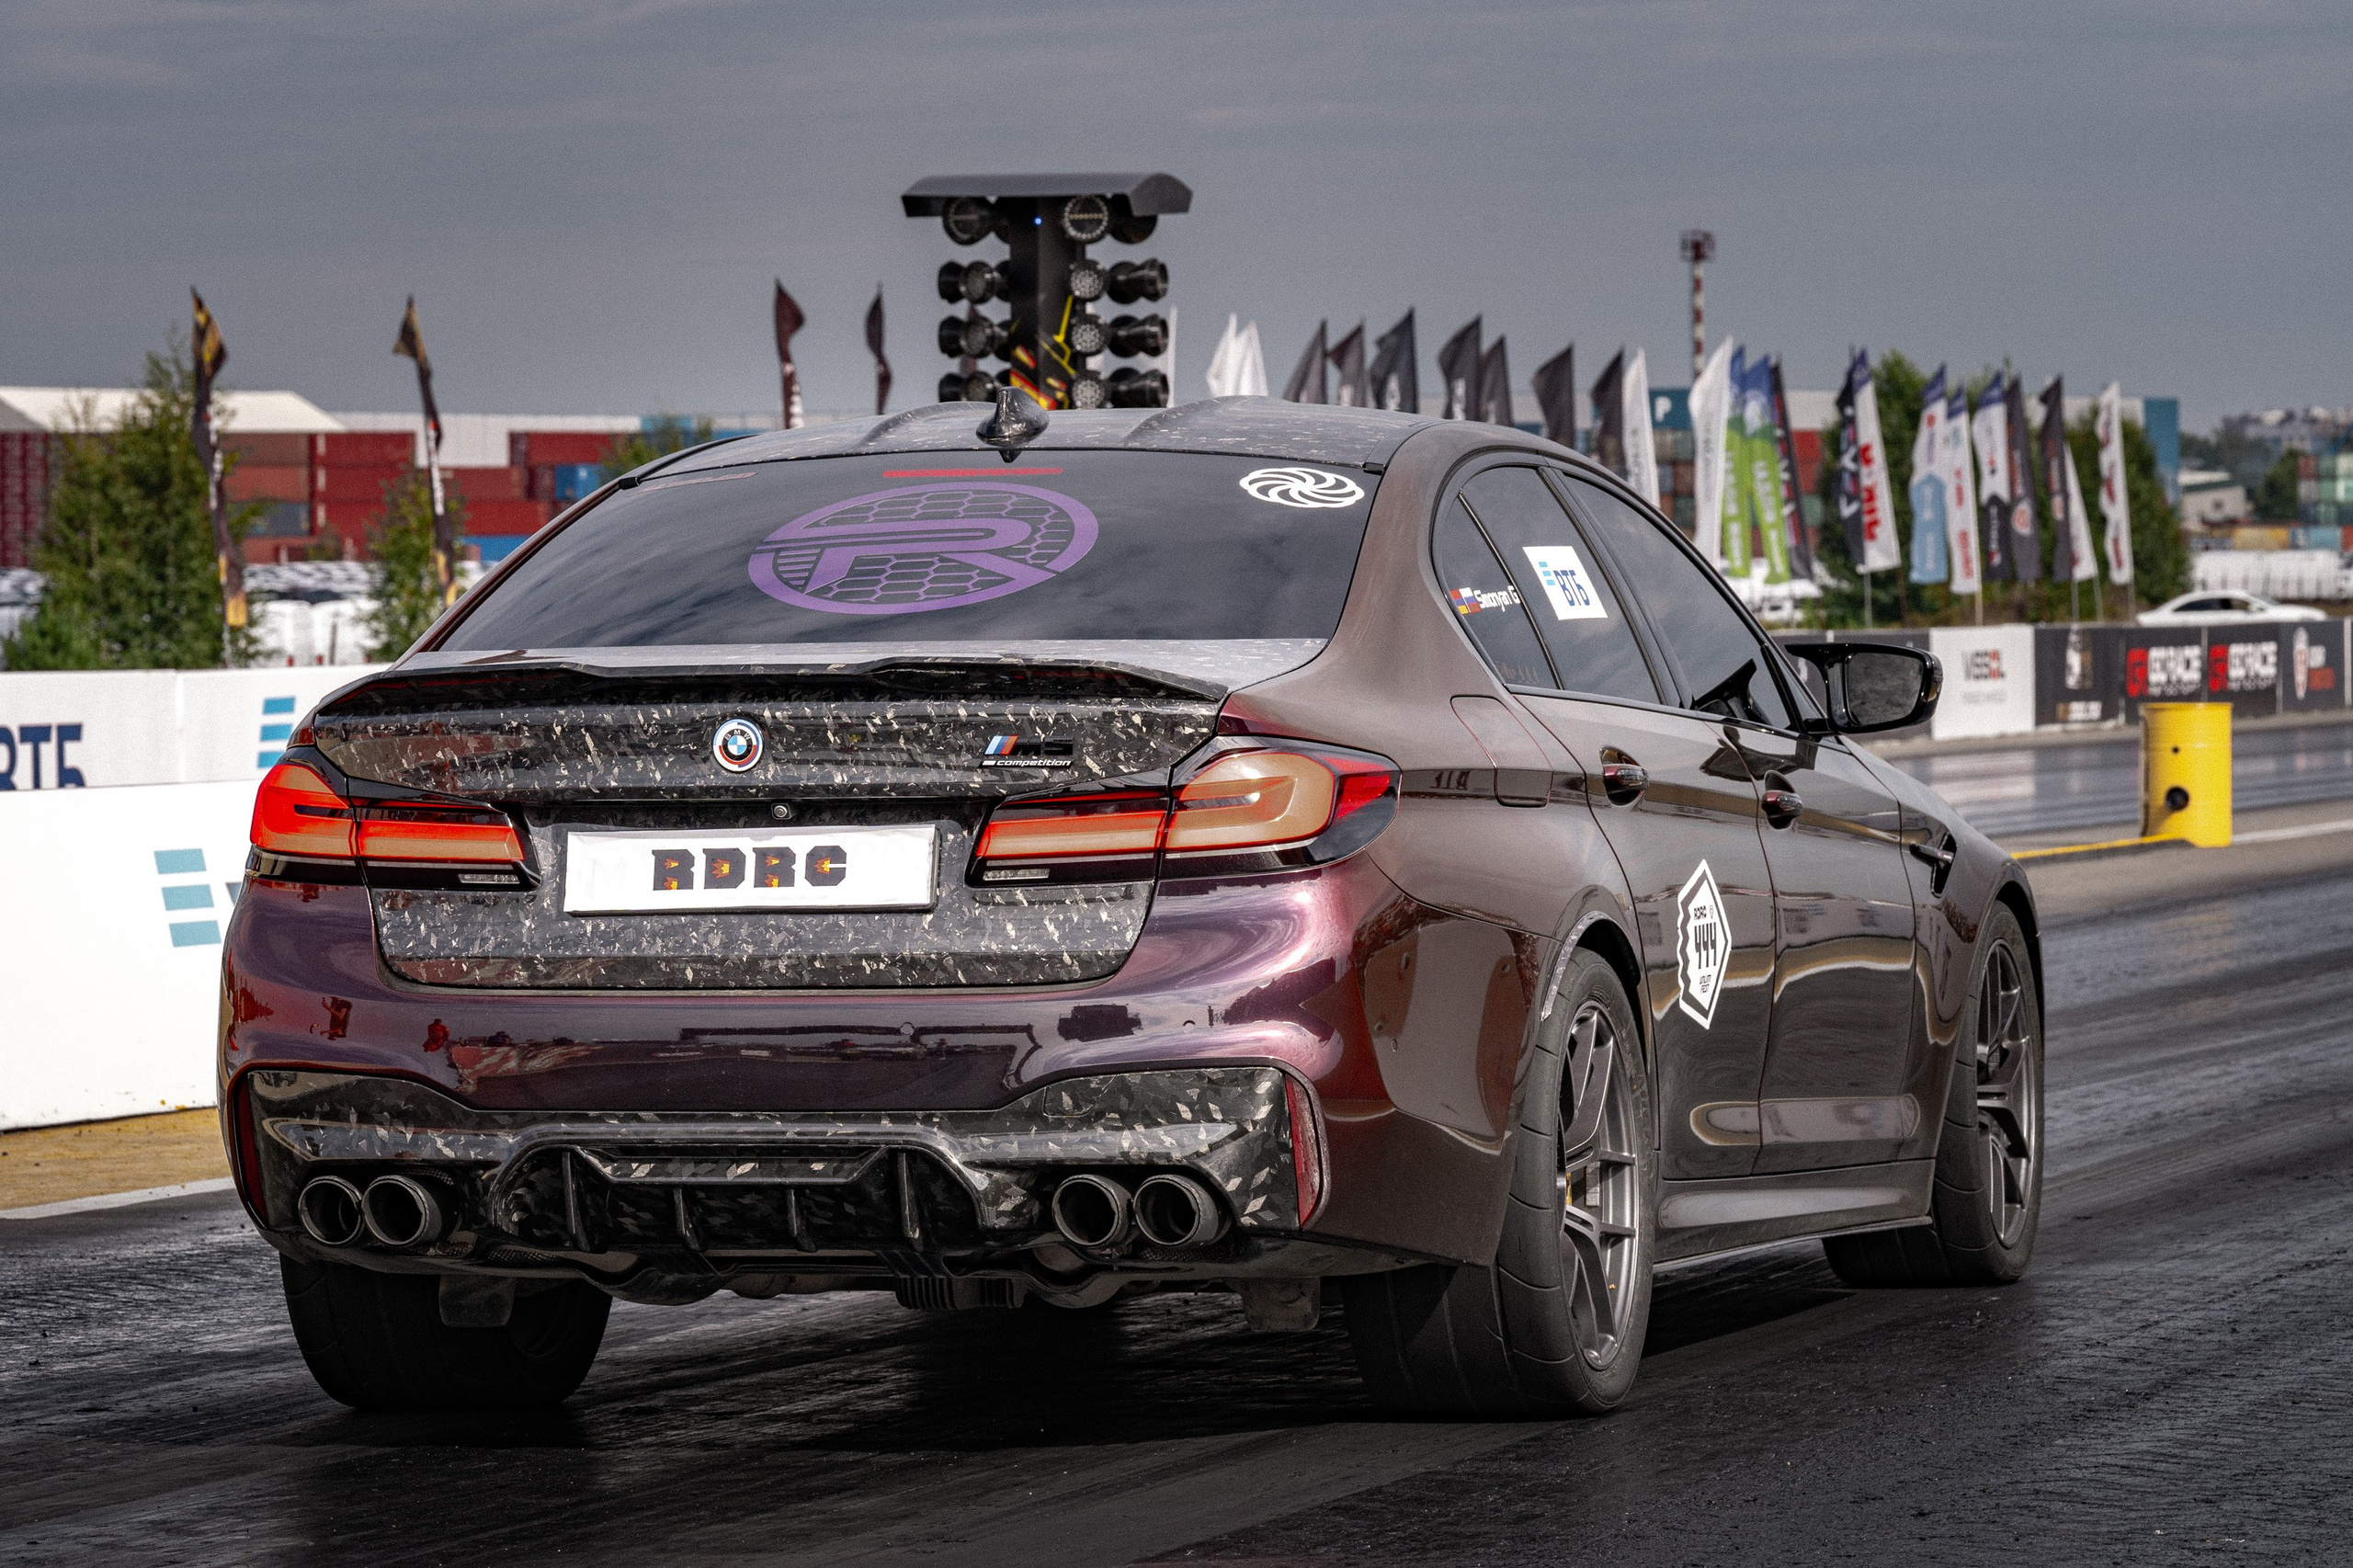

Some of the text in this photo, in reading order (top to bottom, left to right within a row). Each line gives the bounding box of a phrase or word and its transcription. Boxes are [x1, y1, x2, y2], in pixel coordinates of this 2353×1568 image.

[1473, 585, 1521, 612] Simonyan G
[1553, 569, 1591, 607] ВТБ
[724, 729, 751, 741] BMW
[996, 758, 1072, 767] competition
[652, 845, 847, 892] RDRC
[1694, 905, 1707, 919] RDRC
[1694, 922, 1717, 970] 444
